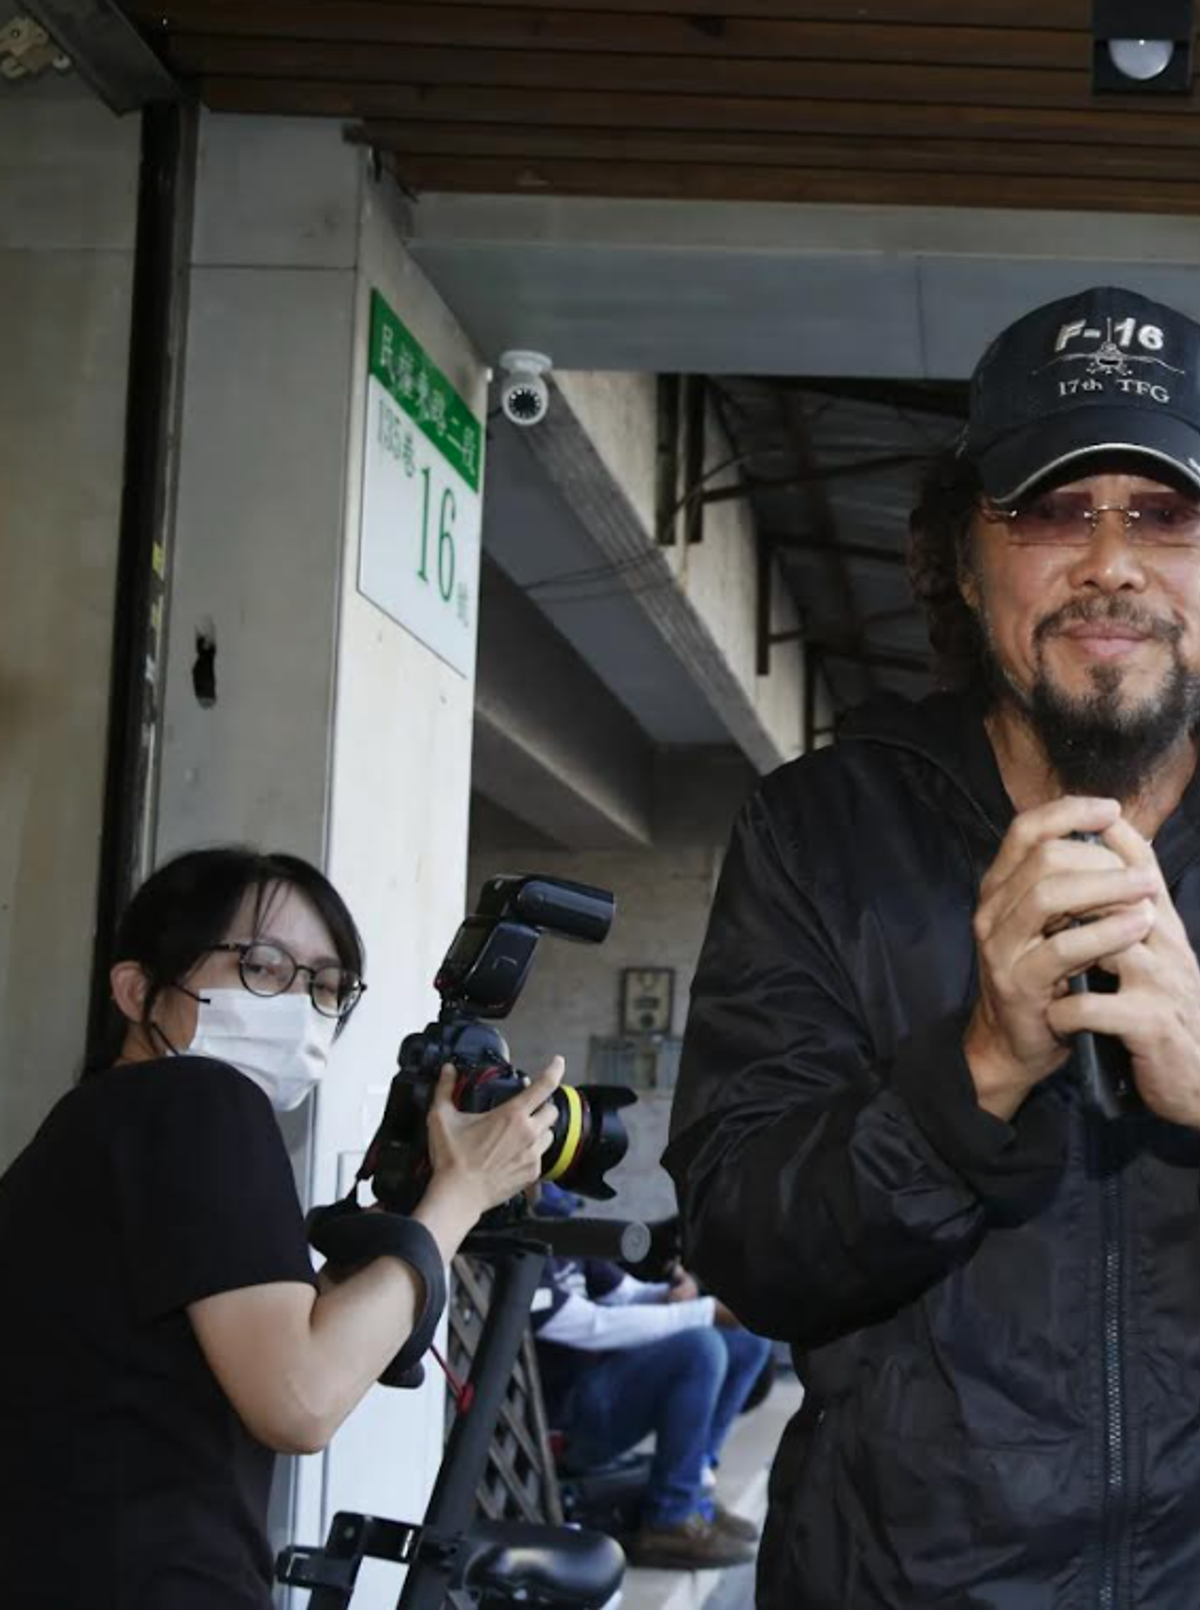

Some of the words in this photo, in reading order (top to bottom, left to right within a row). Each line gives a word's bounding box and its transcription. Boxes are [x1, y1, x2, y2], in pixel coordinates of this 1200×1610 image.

[1055, 317, 1165, 352] F-16
[1058, 378, 1103, 397] 17th
[1116, 378, 1170, 404] TFG
